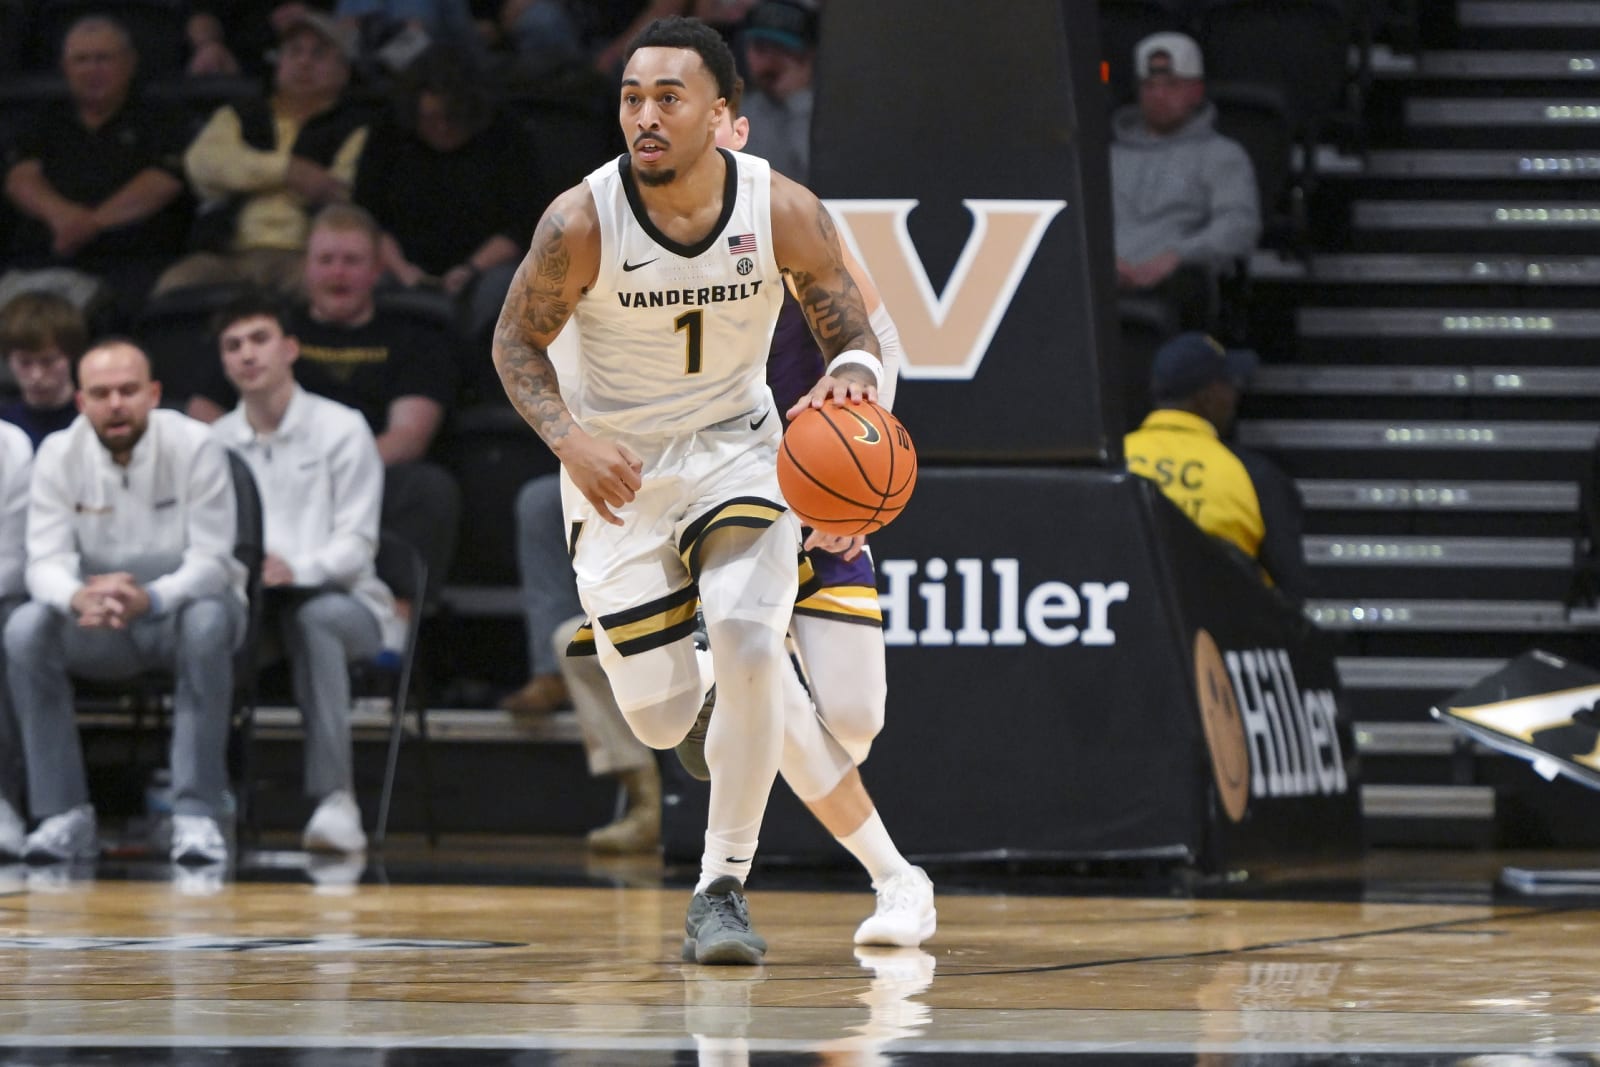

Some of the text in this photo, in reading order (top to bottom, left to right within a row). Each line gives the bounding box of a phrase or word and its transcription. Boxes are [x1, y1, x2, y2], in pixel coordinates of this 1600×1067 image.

[618, 280, 762, 308] VANDERBILT
[737, 258, 753, 275] SEC
[819, 198, 1067, 380] V
[673, 308, 704, 375] 1
[1225, 648, 1347, 797] Hiller
